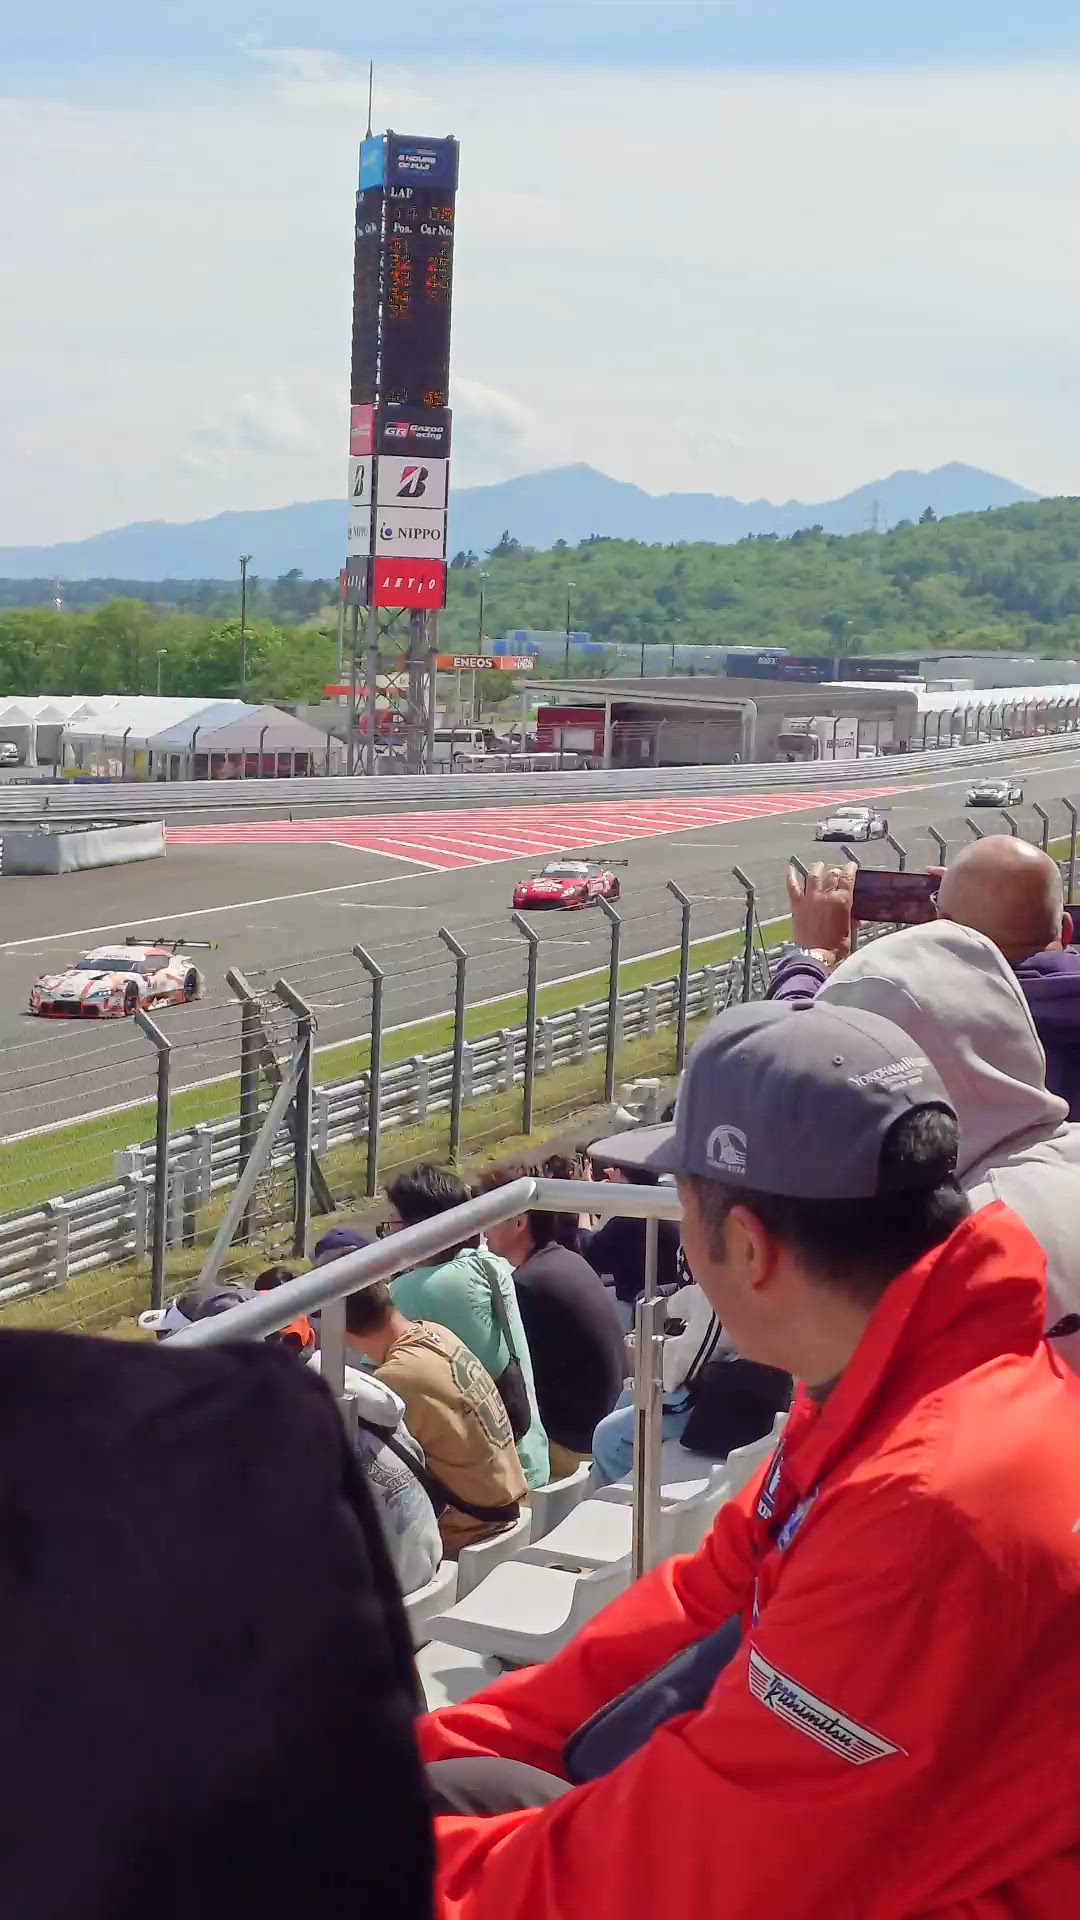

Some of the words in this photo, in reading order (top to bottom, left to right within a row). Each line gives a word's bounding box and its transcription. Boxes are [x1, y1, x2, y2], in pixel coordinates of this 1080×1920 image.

[391, 187, 413, 199] LAP
[421, 223, 437, 236] Car
[385, 427, 407, 438] GR
[397, 527, 441, 541] NIPPO
[453, 657, 493, 668] ENEOS
[769, 1674, 799, 1700] Team
[763, 1687, 853, 1747] Kunimitsu
